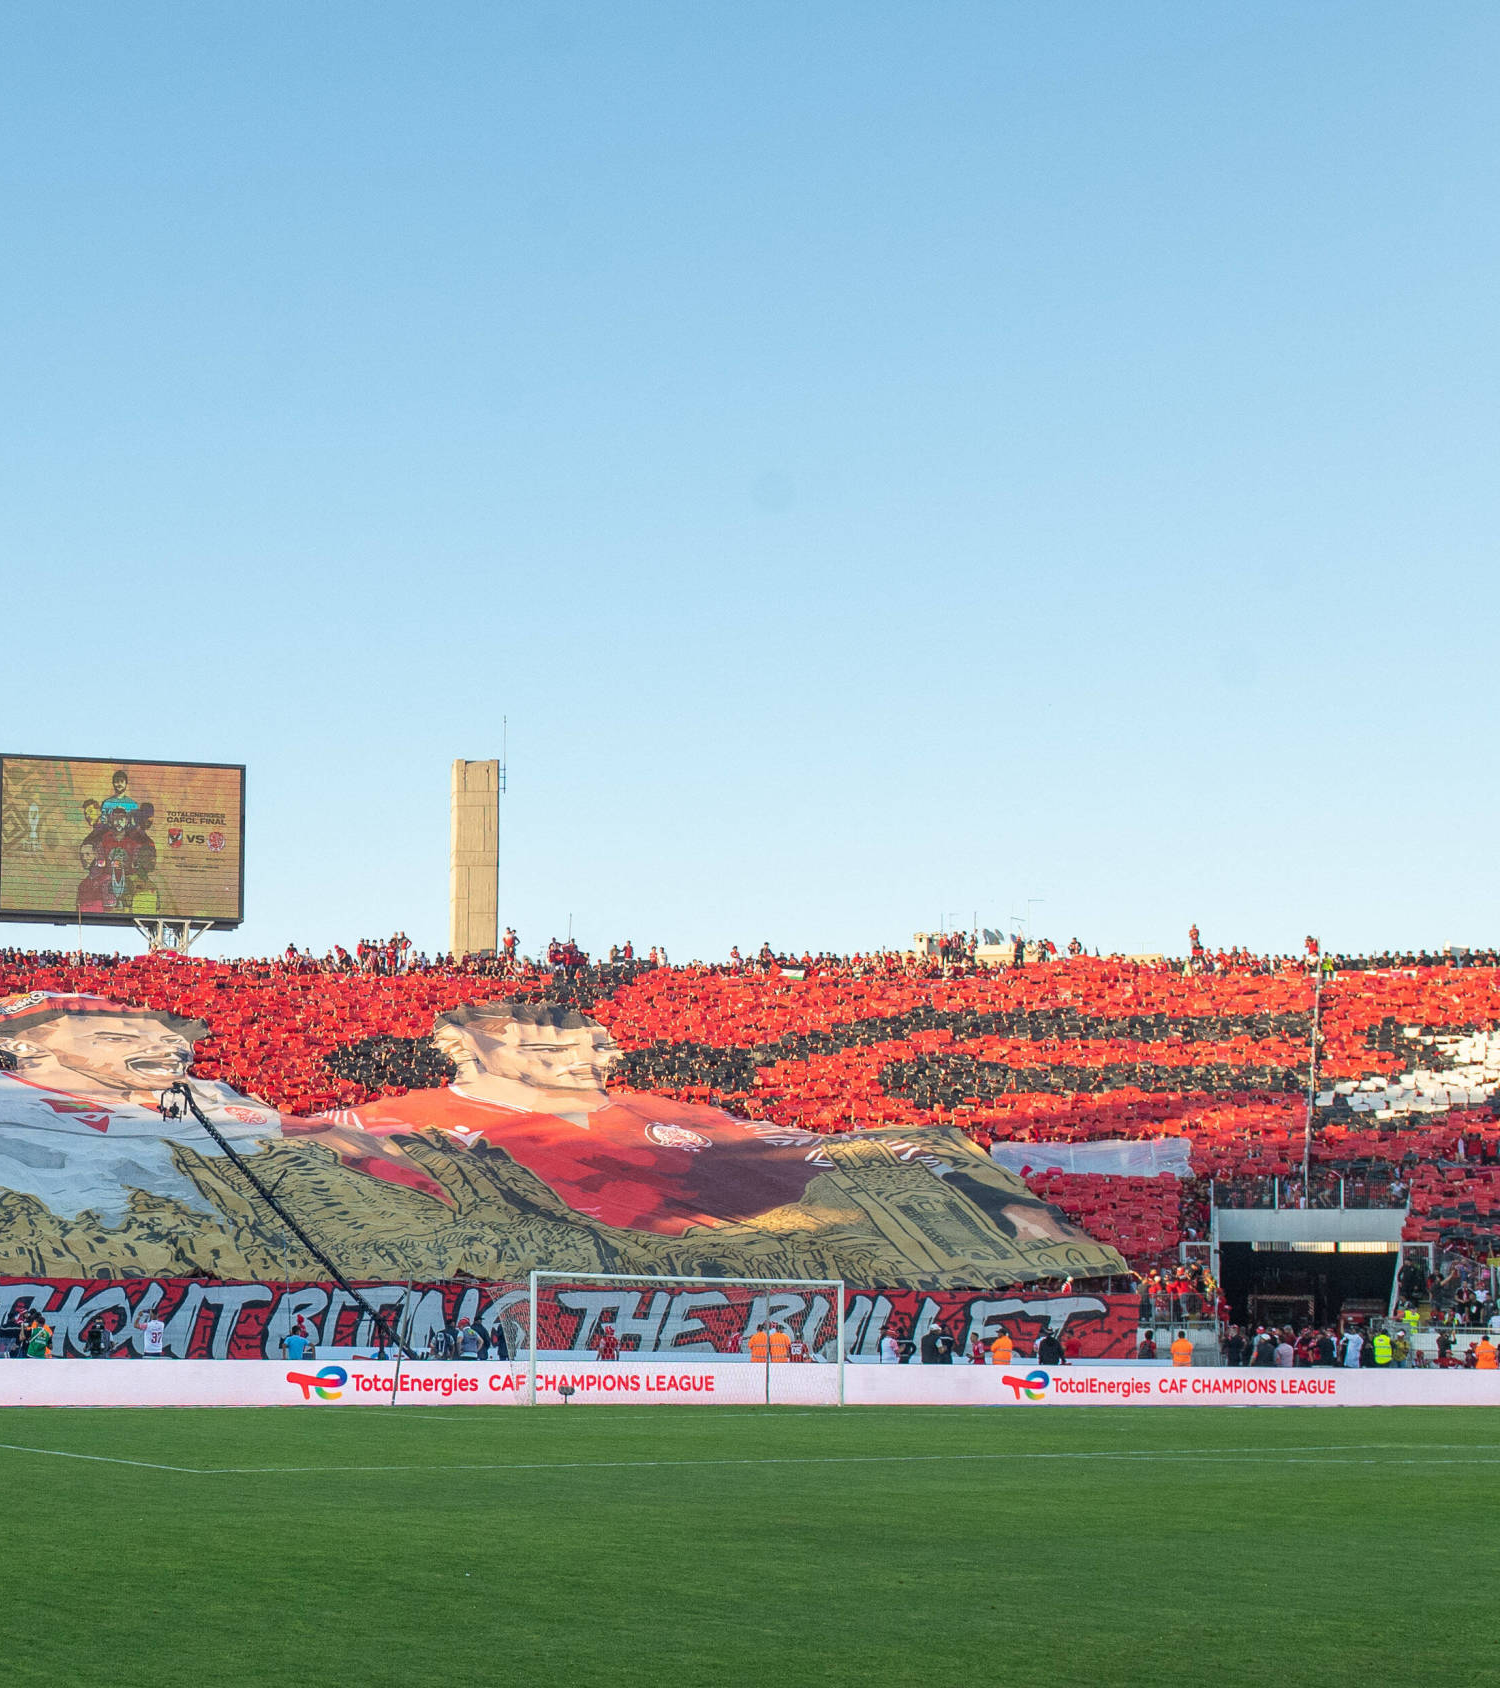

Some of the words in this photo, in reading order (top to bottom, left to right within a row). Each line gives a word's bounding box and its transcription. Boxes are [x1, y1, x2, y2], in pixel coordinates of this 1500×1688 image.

[200, 818, 227, 826] FINAL
[186, 834, 205, 844] VS
[557, 1290, 732, 1352] THE
[151, 1332, 162, 1344] 37
[351, 1373, 478, 1396] TotaEnergies
[489, 1374, 526, 1391] CAF
[534, 1374, 639, 1391] CHAMPIONS
[646, 1374, 714, 1391] LEAGUE
[1052, 1378, 1151, 1397] TotalEnergies
[1158, 1379, 1187, 1393] CAF
[1192, 1379, 1276, 1393] CHAMPIONS
[1280, 1380, 1336, 1394] LEAGUE
